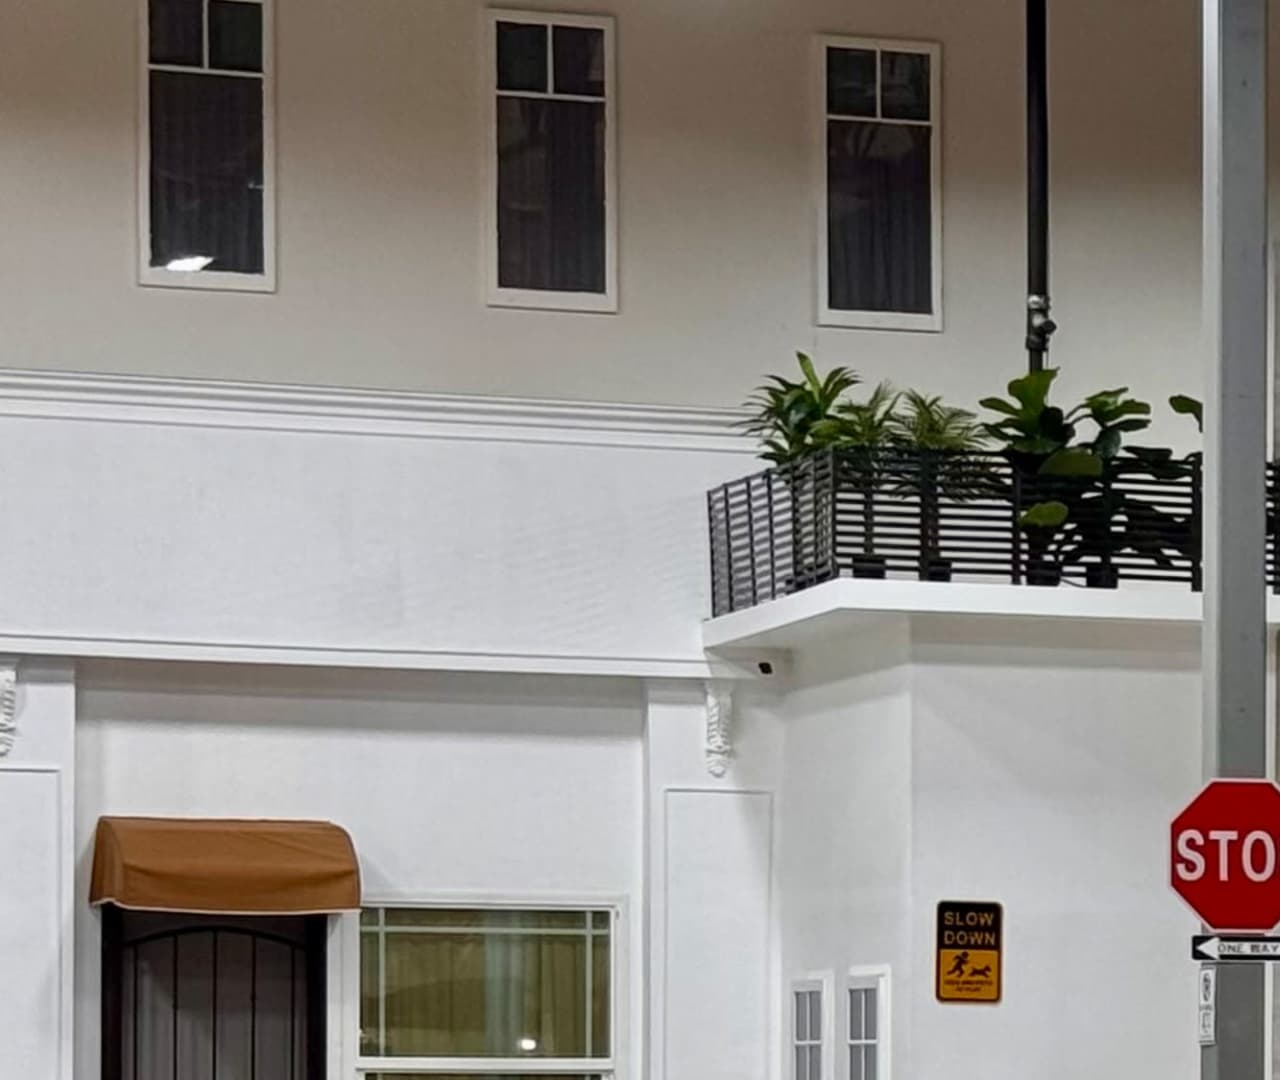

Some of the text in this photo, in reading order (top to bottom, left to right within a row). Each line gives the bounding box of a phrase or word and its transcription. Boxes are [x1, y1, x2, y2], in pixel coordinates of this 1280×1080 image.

[943, 911, 995, 927] SLOW
[943, 929, 997, 945] DOWN
[1217, 943, 1280, 953] ONE WAY
